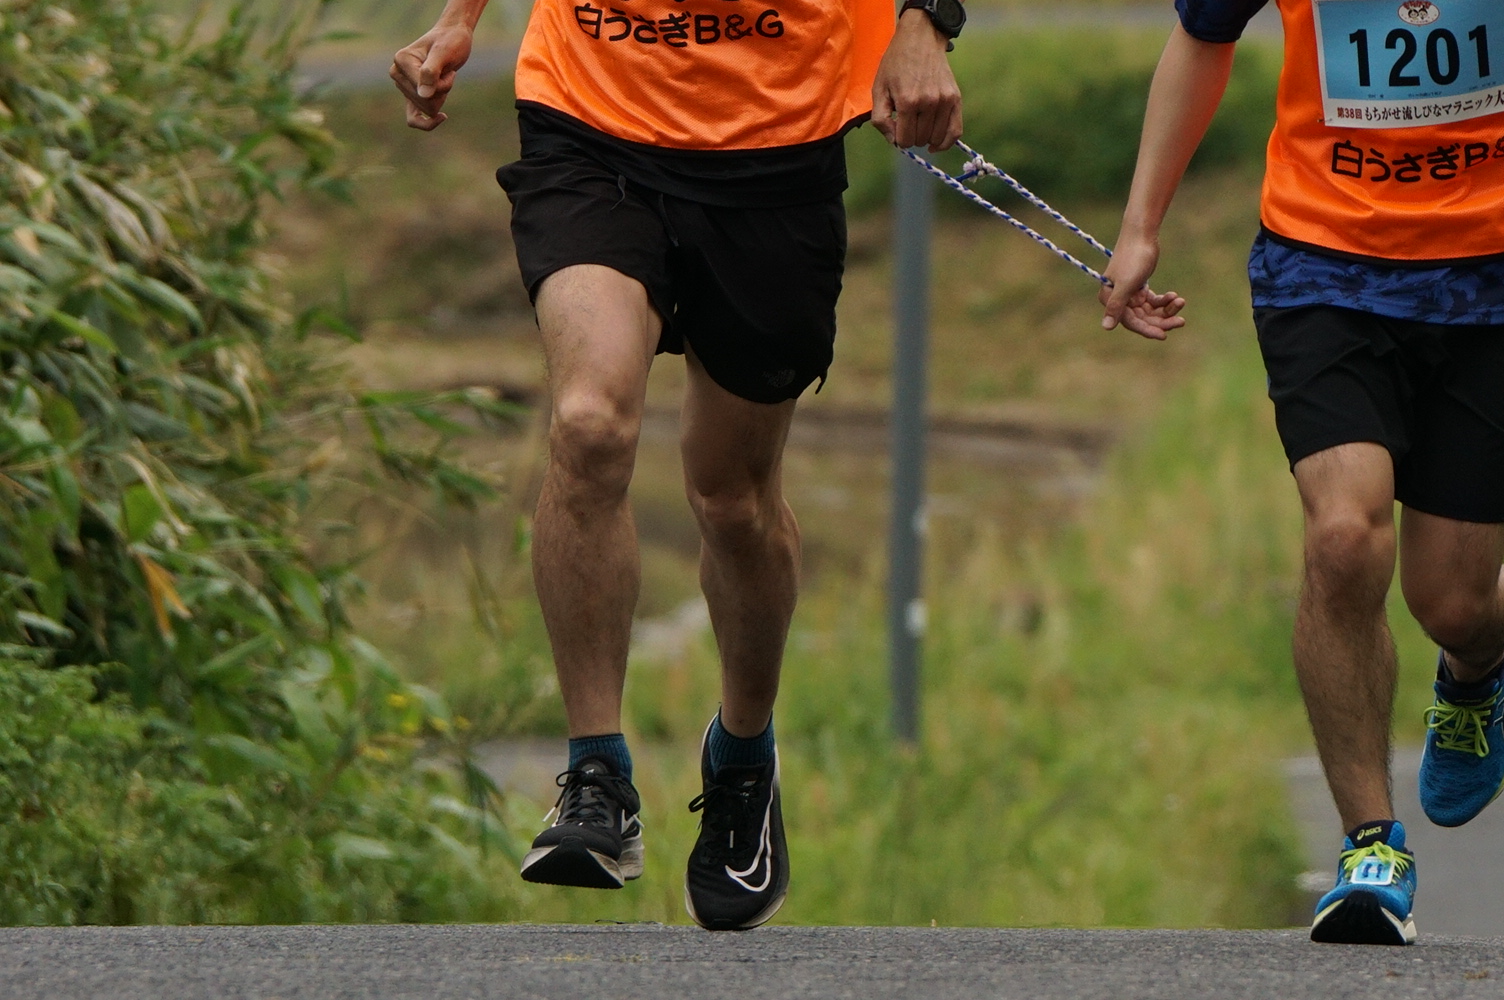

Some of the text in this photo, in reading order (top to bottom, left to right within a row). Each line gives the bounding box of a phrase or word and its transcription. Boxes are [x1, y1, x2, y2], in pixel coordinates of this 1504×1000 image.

[574, 2, 785, 47] 白うさぎB&G
[1349, 24, 1490, 87] 1201
